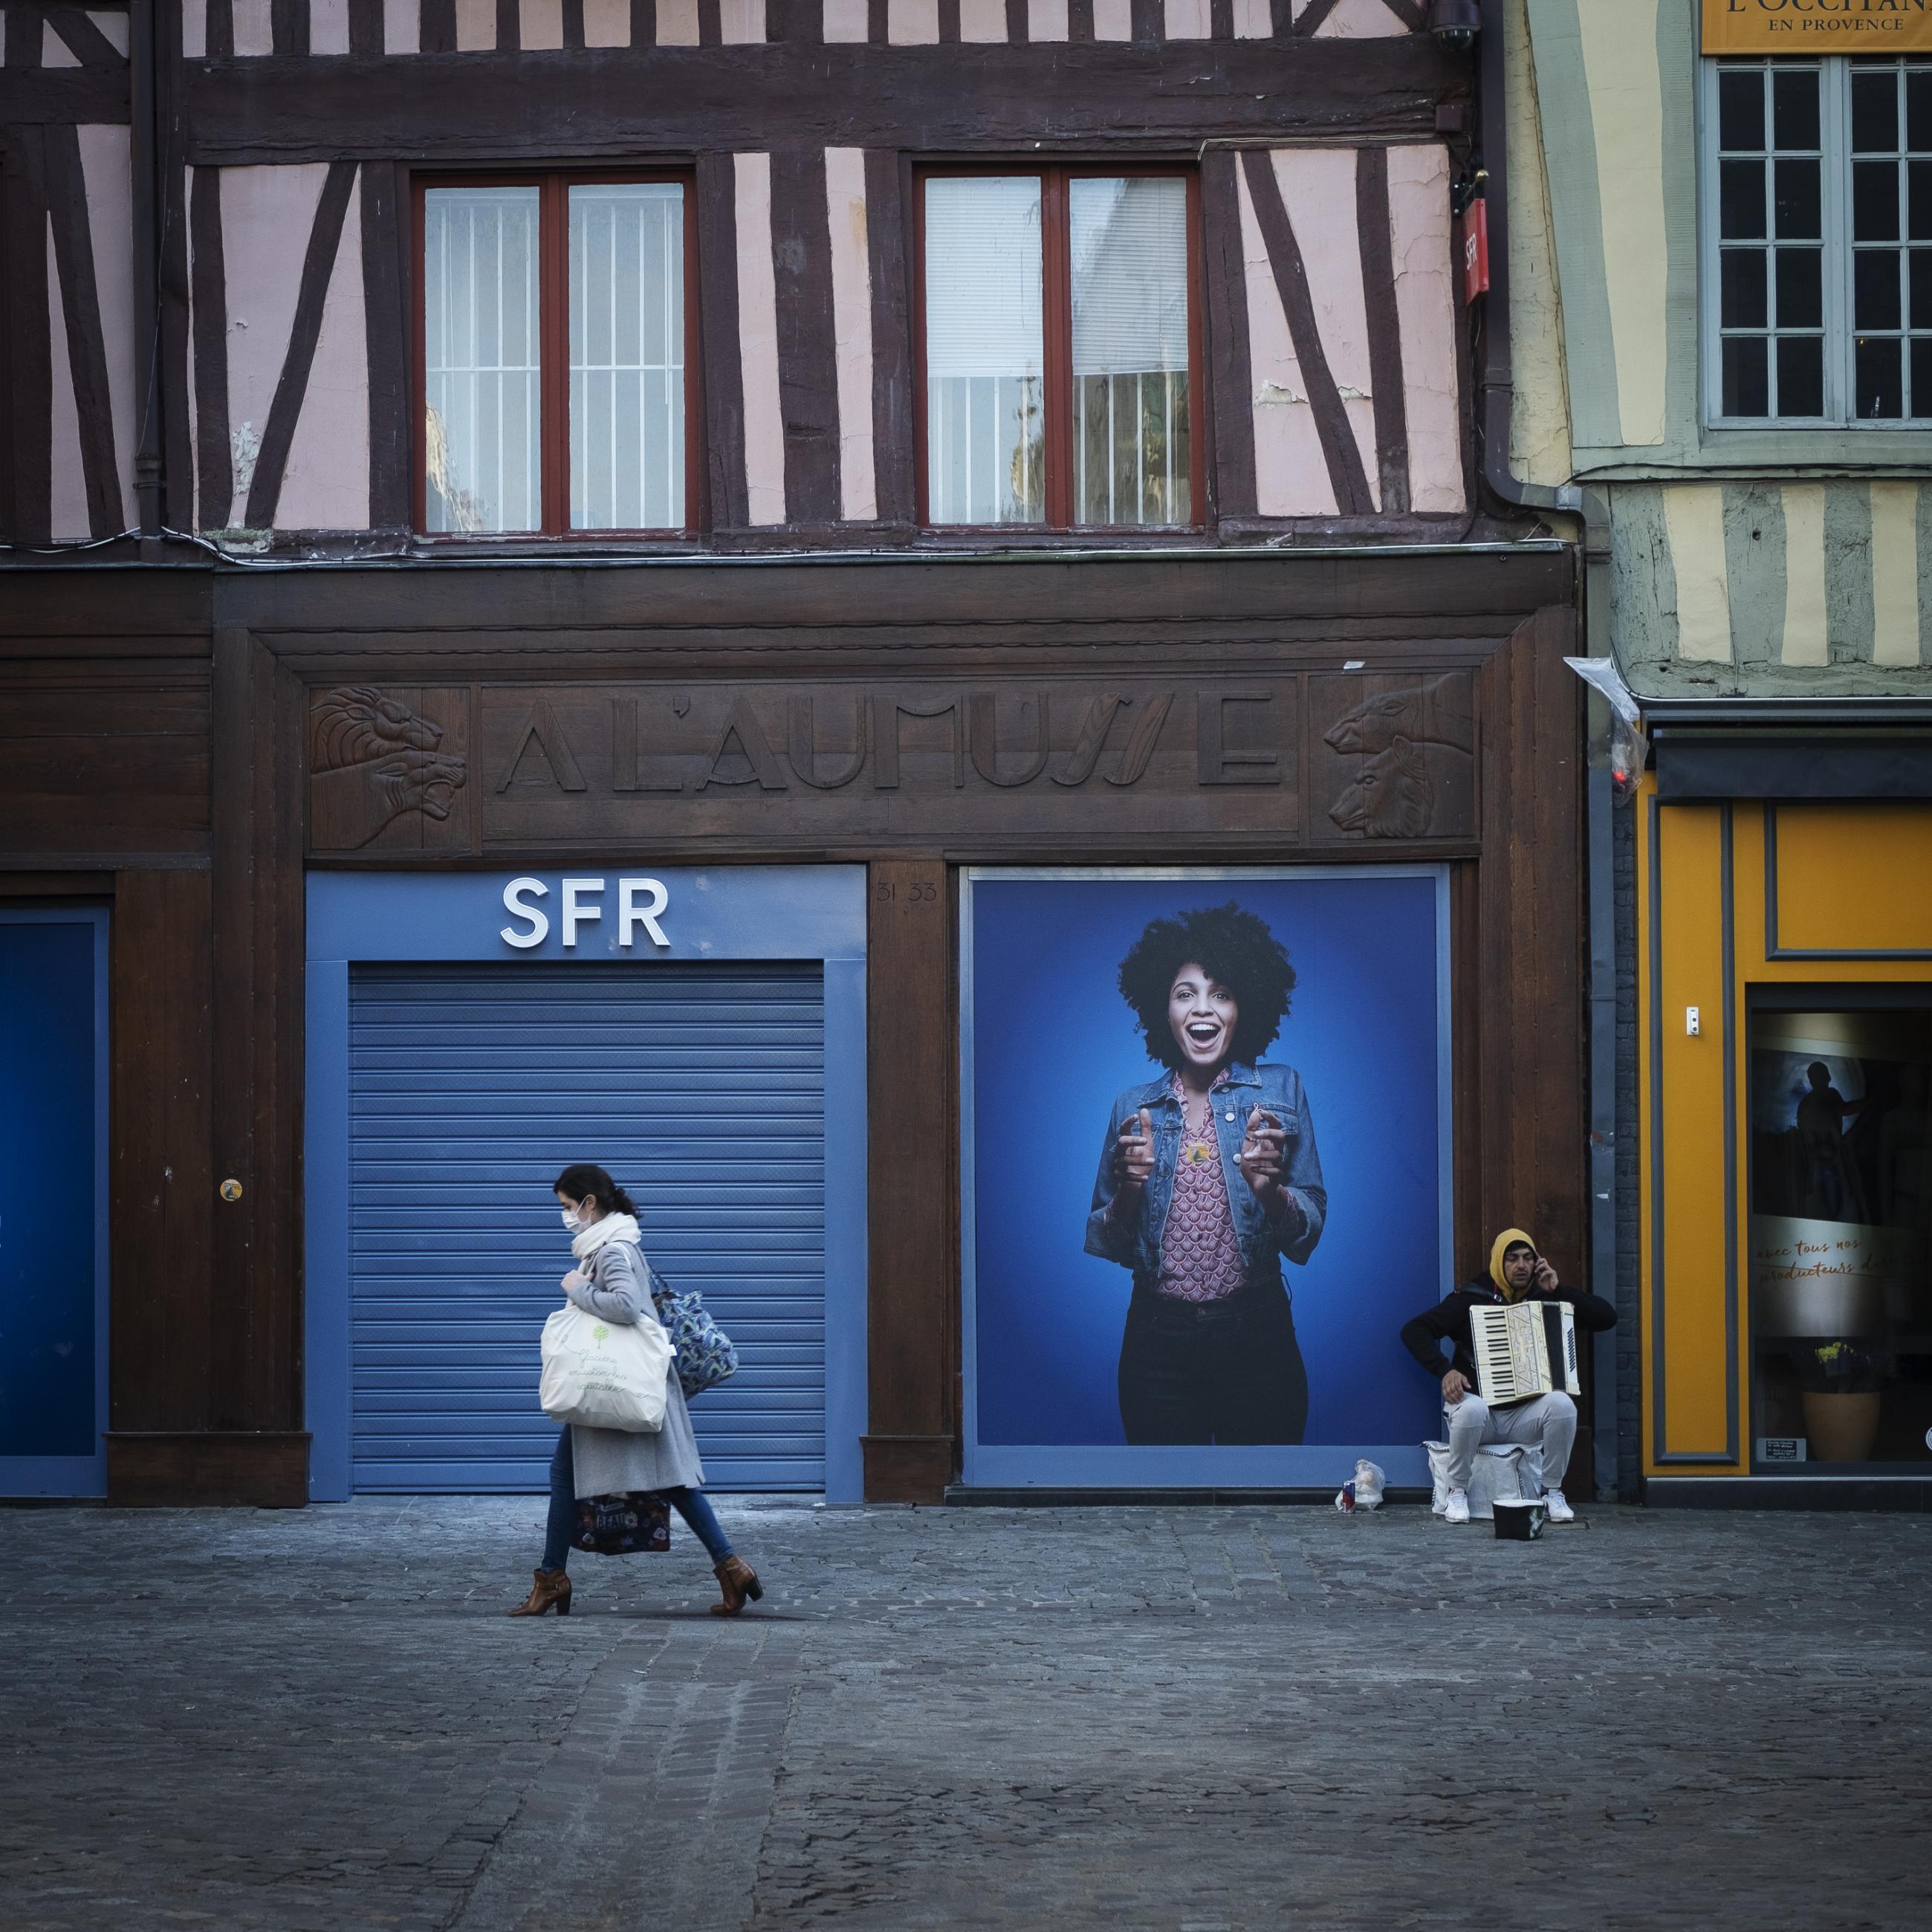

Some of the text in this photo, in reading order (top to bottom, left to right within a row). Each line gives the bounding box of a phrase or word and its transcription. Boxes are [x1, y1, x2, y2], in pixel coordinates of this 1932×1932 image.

[1768, 18, 1904, 31] EN PROVENCE
[496, 698, 588, 793] A
[877, 883, 936, 901] 31 33
[500, 877, 671, 948] SFR
[1794, 1239, 1831, 1257] tous
[1835, 1239, 1862, 1250] nos
